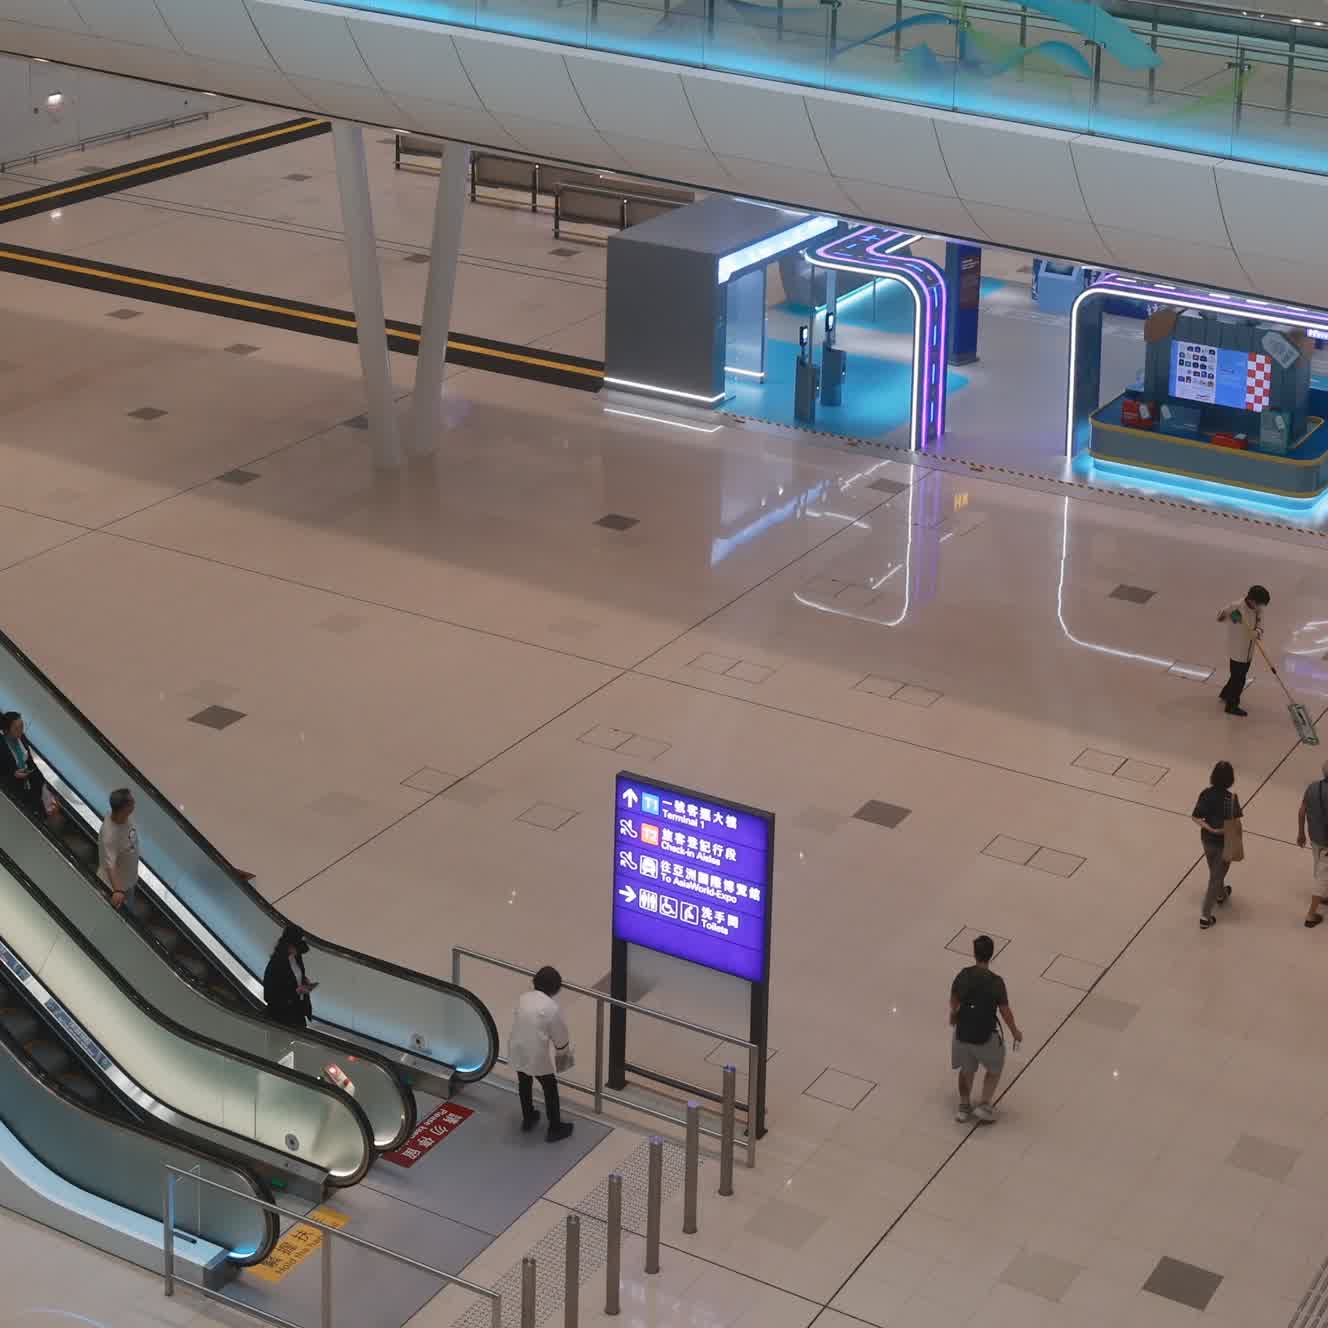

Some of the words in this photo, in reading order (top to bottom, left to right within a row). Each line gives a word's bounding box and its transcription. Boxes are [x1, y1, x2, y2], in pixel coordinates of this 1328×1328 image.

[661, 808, 699, 828] Terminal
[700, 820, 706, 829] 1
[660, 841, 696, 860] Check-in
[696, 850, 721, 866] Aisles
[660, 872, 672, 884] To
[672, 876, 738, 905] AsiaWorld-Expo
[700, 919, 729, 936] Toilets
[701, 905, 740, 929] 洗手間
